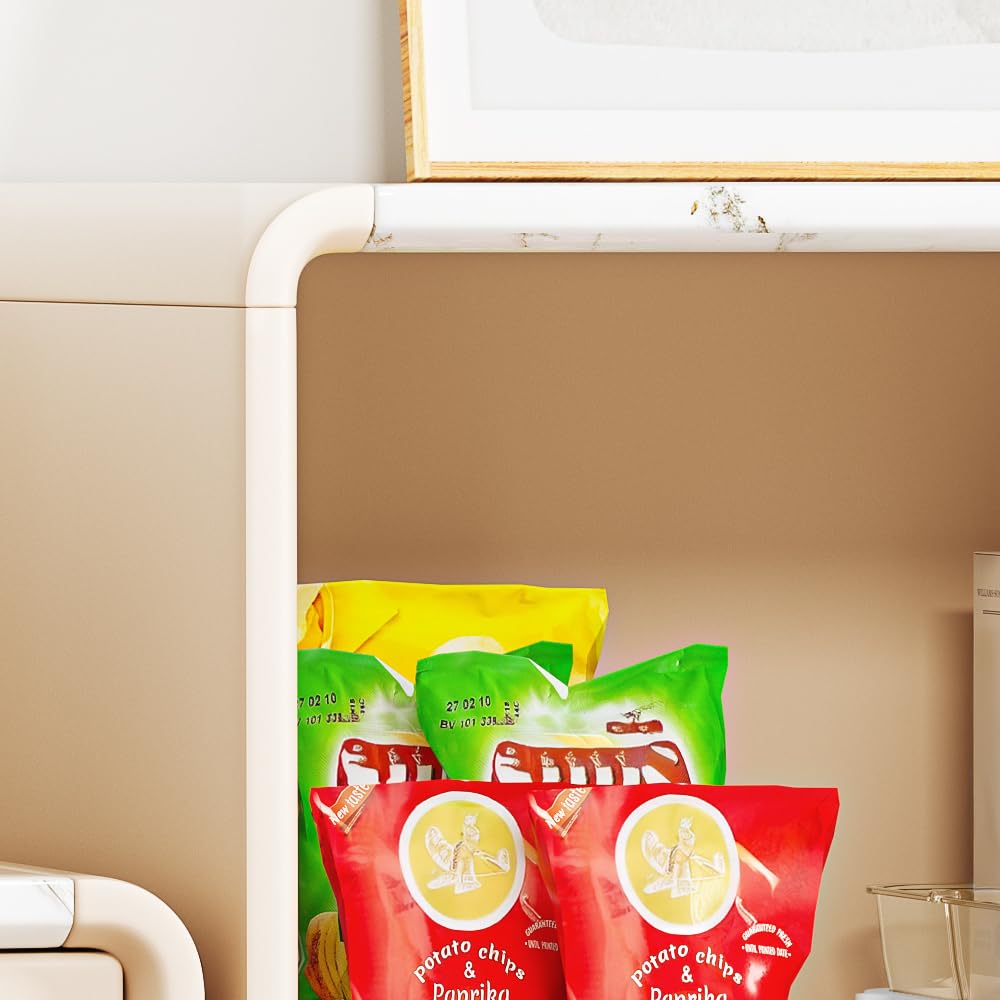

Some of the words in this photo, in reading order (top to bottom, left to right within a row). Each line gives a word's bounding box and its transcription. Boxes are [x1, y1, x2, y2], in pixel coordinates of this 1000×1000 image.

[309, 695, 321, 707] 02
[324, 692, 337, 704] 10
[446, 700, 459, 712] 27
[463, 697, 475, 710] 02
[479, 695, 491, 707] 10
[440, 719, 456, 729] BV
[463, 960, 477, 979] &
[478, 943, 526, 980] chips
[695, 946, 743, 985] chips
[681, 965, 694, 983] &
